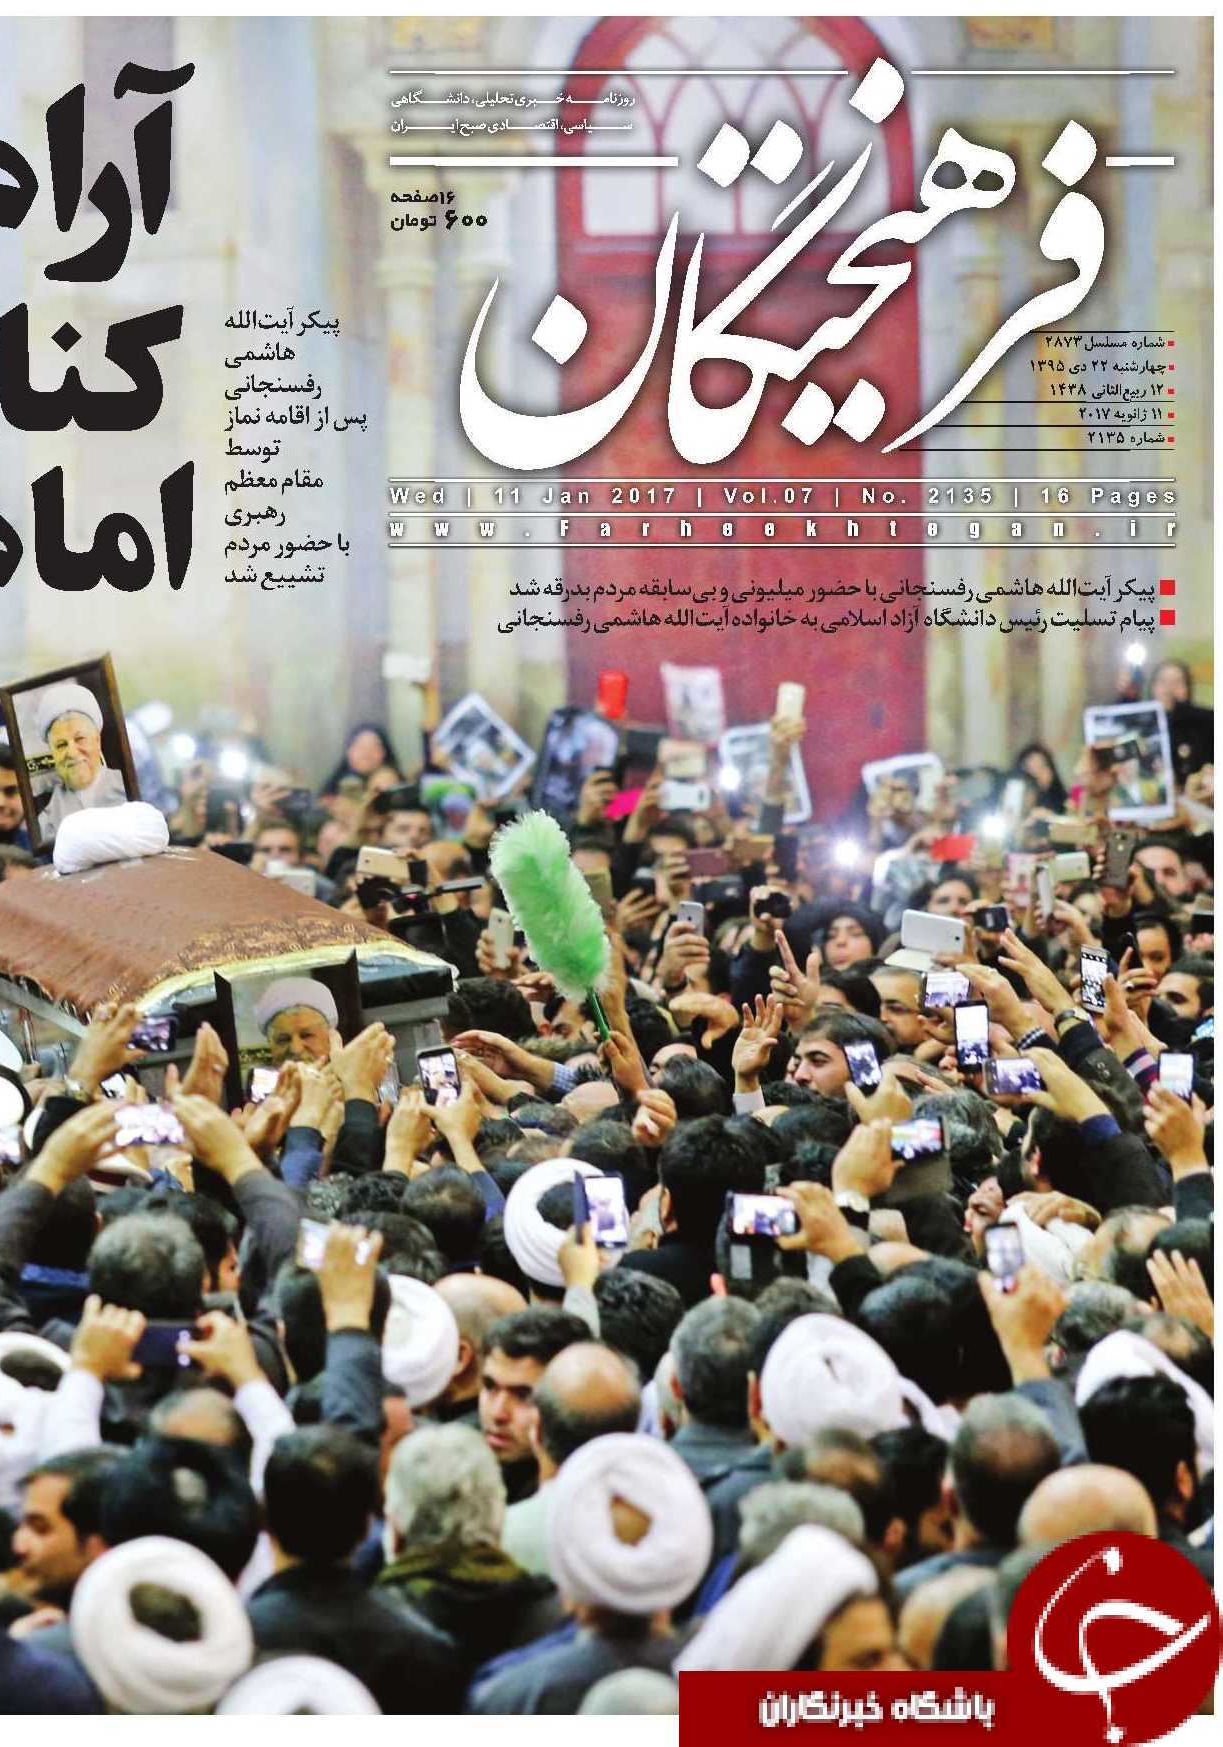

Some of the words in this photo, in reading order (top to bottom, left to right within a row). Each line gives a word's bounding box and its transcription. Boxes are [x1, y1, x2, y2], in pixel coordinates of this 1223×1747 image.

[391, 90, 470, 108] دانشگاهی
[514, 92, 565, 108] خبری
[565, 92, 635, 107] روزنامه
[391, 118, 459, 134] ایران
[459, 122, 487, 137] صبح
[487, 118, 559, 134] اقتصادی
[390, 213, 437, 232] تومان
[444, 209, 488, 231] ۶۰۰
[460, 58, 1104, 470] فرهیختگان
[300, 310, 341, 333] پیکر
[1045, 335, 1083, 348] ۲۸۷۳
[1084, 335, 1128, 352] مسلسل
[1131, 335, 1166, 351] شماره
[224, 341, 296, 368] هاشمی
[1030, 359, 1065, 372] ۱۳۹۵
[1068, 363, 1087, 375] دی
[1091, 359, 1108, 372] ۲۲
[1112, 359, 1167, 376] چهارشنبه
[224, 372, 322, 400] رفسنجانی
[1050, 382, 1087, 396] ۱۴۳۸
[1150, 383, 1164, 396] ۱۲
[224, 405, 261, 432] نماز
[265, 404, 310, 425] اقامه
[313, 406, 329, 432] از
[333, 414, 368, 433] پس
[1078, 407, 1111, 420] ۲۰۱۷
[1113, 407, 1148, 423] ژانویه
[1151, 407, 1162, 420] ۱۱
[1087, 431, 1125, 444] ۲۱۳۵
[1130, 431, 1166, 447] شماره
[224, 437, 282, 460] توسط
[224, 469, 278, 493] معظم
[281, 471, 324, 493] مقام
[389, 487, 444, 505] Wed
[494, 487, 520, 504] 11
[542, 487, 589, 504] Jan
[611, 487, 675, 504] 2017
[723, 487, 813, 504] Vol.07
[861, 487, 906, 504] No.
[927, 487, 992, 504] 2135
[1040, 487, 1069, 504] 16
[1090, 487, 1176, 508] Pages
[224, 505, 286, 527] رهبری
[389, 518, 1176, 539] www.Farheekhtegan.ir
[224, 537, 271, 559] مردم
[274, 534, 333, 559] حضور
[337, 533, 350, 557] با
[224, 565, 258, 583] شد
[260, 564, 326, 591] تشییع
[509, 578, 541, 596] شد
[542, 577, 591, 603] بدرقه
[593, 584, 637, 603] مردم
[720, 586, 729, 603] و
[731, 578, 805, 604] میلیونی
[808, 585, 861, 603] حضور
[865, 579, 877, 601] با
[879, 577, 974, 604] رفسنجانی
[975, 577, 1044, 604] هاشمی
[1112, 577, 1155, 604] پیکر
[497, 607, 591, 634] رفسنجانی
[593, 609, 662, 634] هاشمی
[731, 608, 797, 634] خانواده
[800, 613, 818, 631] به
[820, 609, 887, 634] اسلامی
[890, 605, 919, 634] آزاد
[923, 607, 997, 627] دانشگاه
[999, 608, 1048, 634] رئیس
[1050, 607, 1118, 632] تسلیت
[1119, 609, 1156, 634] پیام
